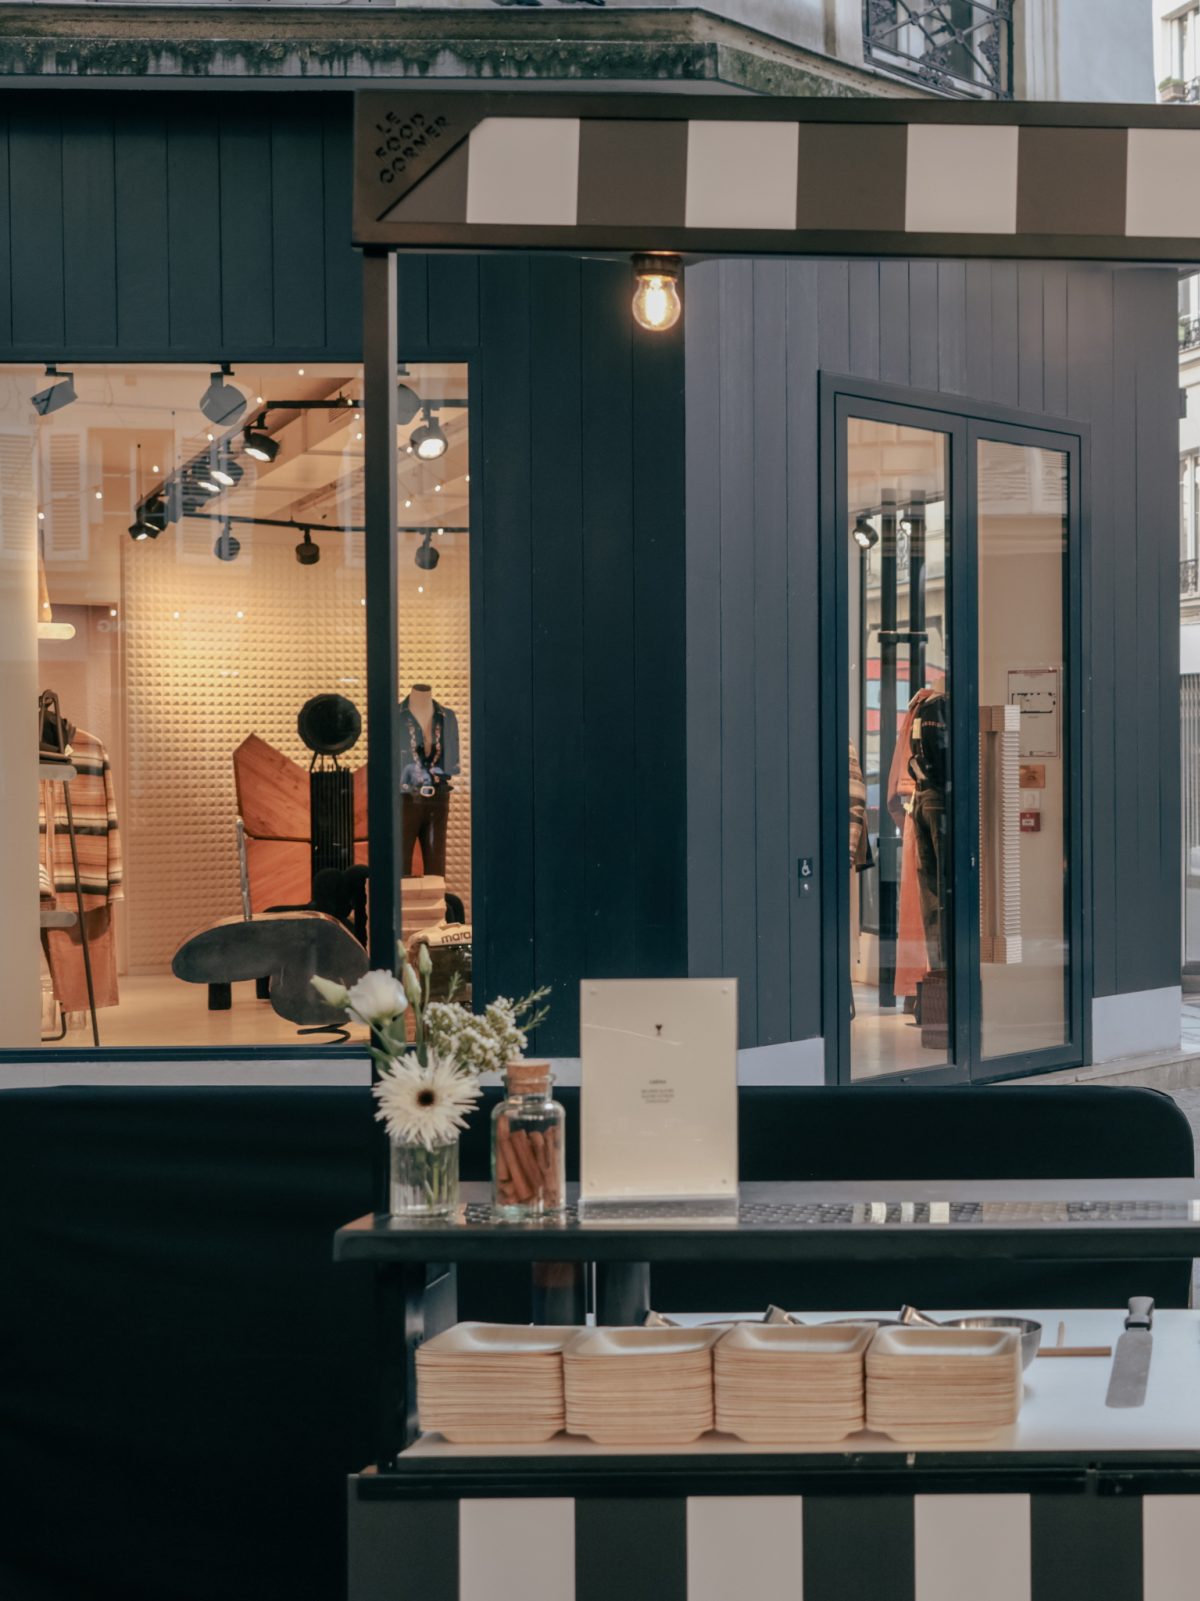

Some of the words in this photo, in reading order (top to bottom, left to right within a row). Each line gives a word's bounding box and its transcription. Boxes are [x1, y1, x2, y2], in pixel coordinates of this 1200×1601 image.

[375, 113, 425, 157] FOOD
[376, 111, 401, 134] LE
[380, 116, 448, 183] CORNER
